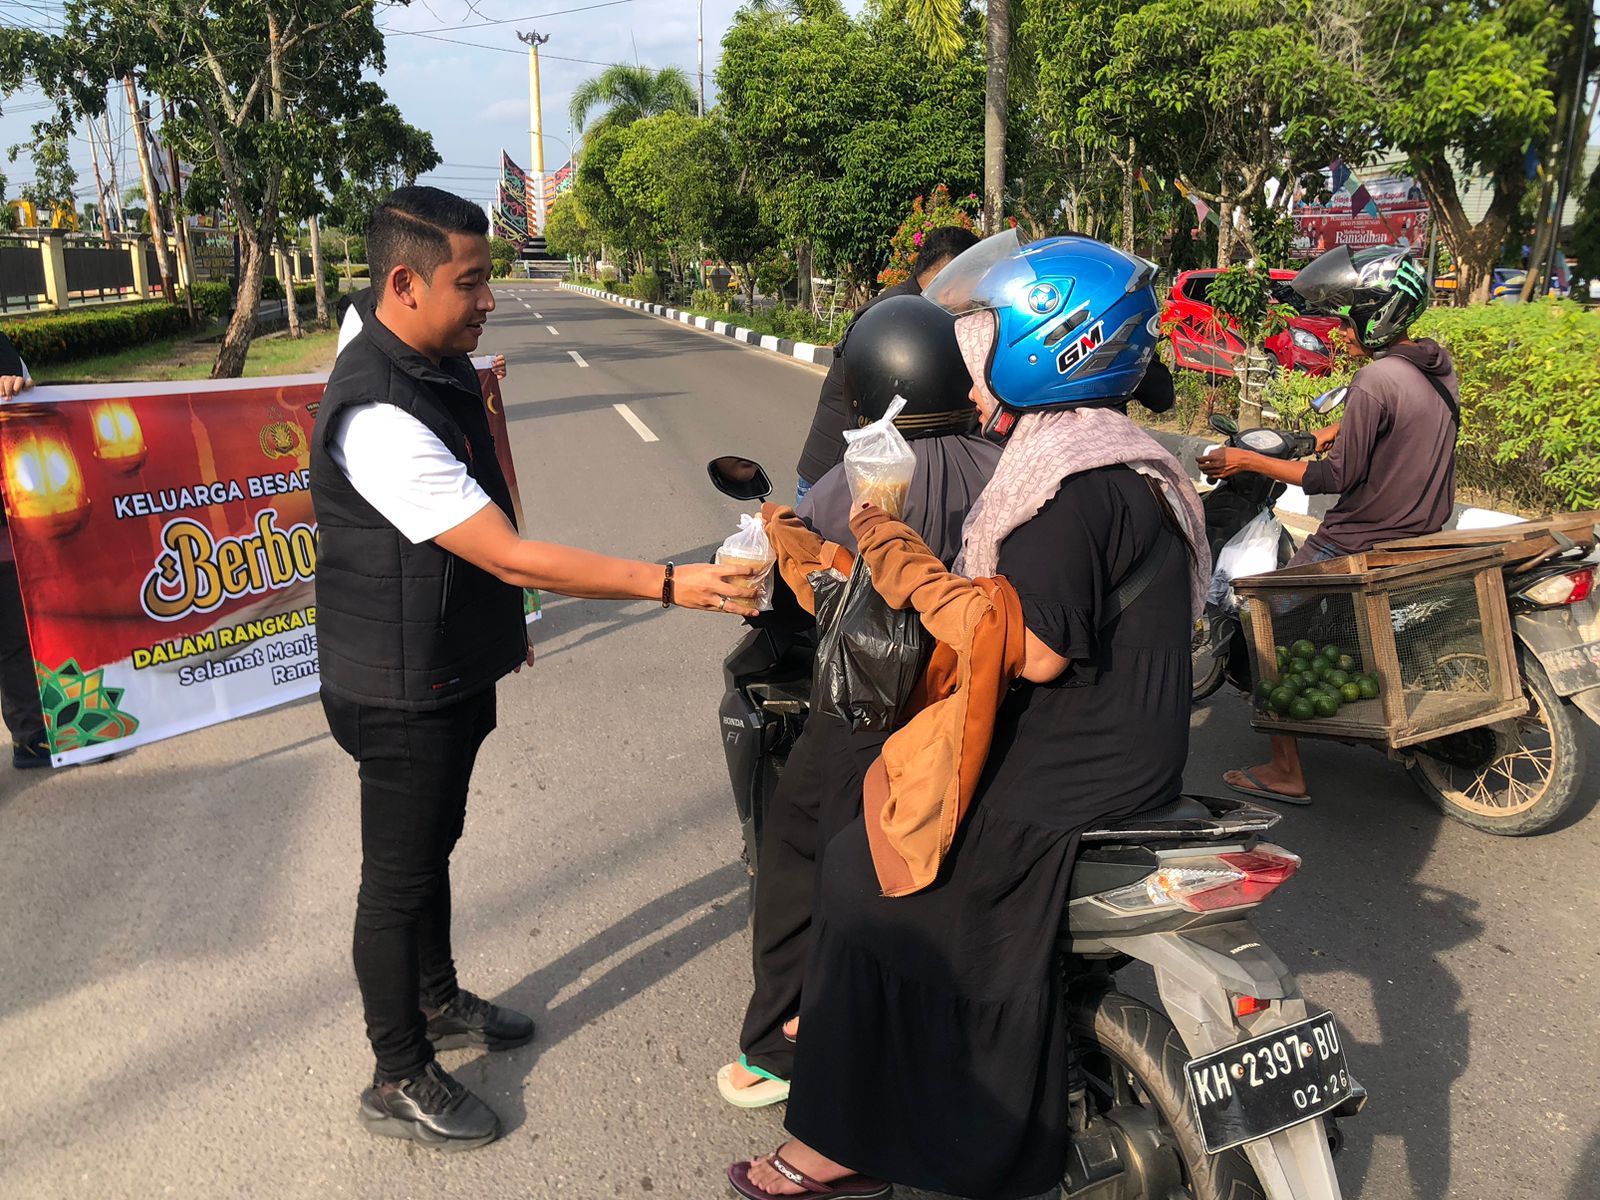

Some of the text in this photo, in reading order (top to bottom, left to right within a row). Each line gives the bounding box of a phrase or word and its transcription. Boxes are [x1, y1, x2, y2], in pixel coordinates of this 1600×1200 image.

[1335, 229, 1388, 244] Ramadhan
[1057, 320, 1103, 374] GM
[114, 480, 242, 518] KELUARGA
[133, 634, 215, 669] DALAM
[218, 610, 304, 648] RANGKA
[179, 650, 263, 686] Selamat
[723, 716, 745, 728] HONDA
[1194, 1020, 1339, 1106] KH 2397 BU
